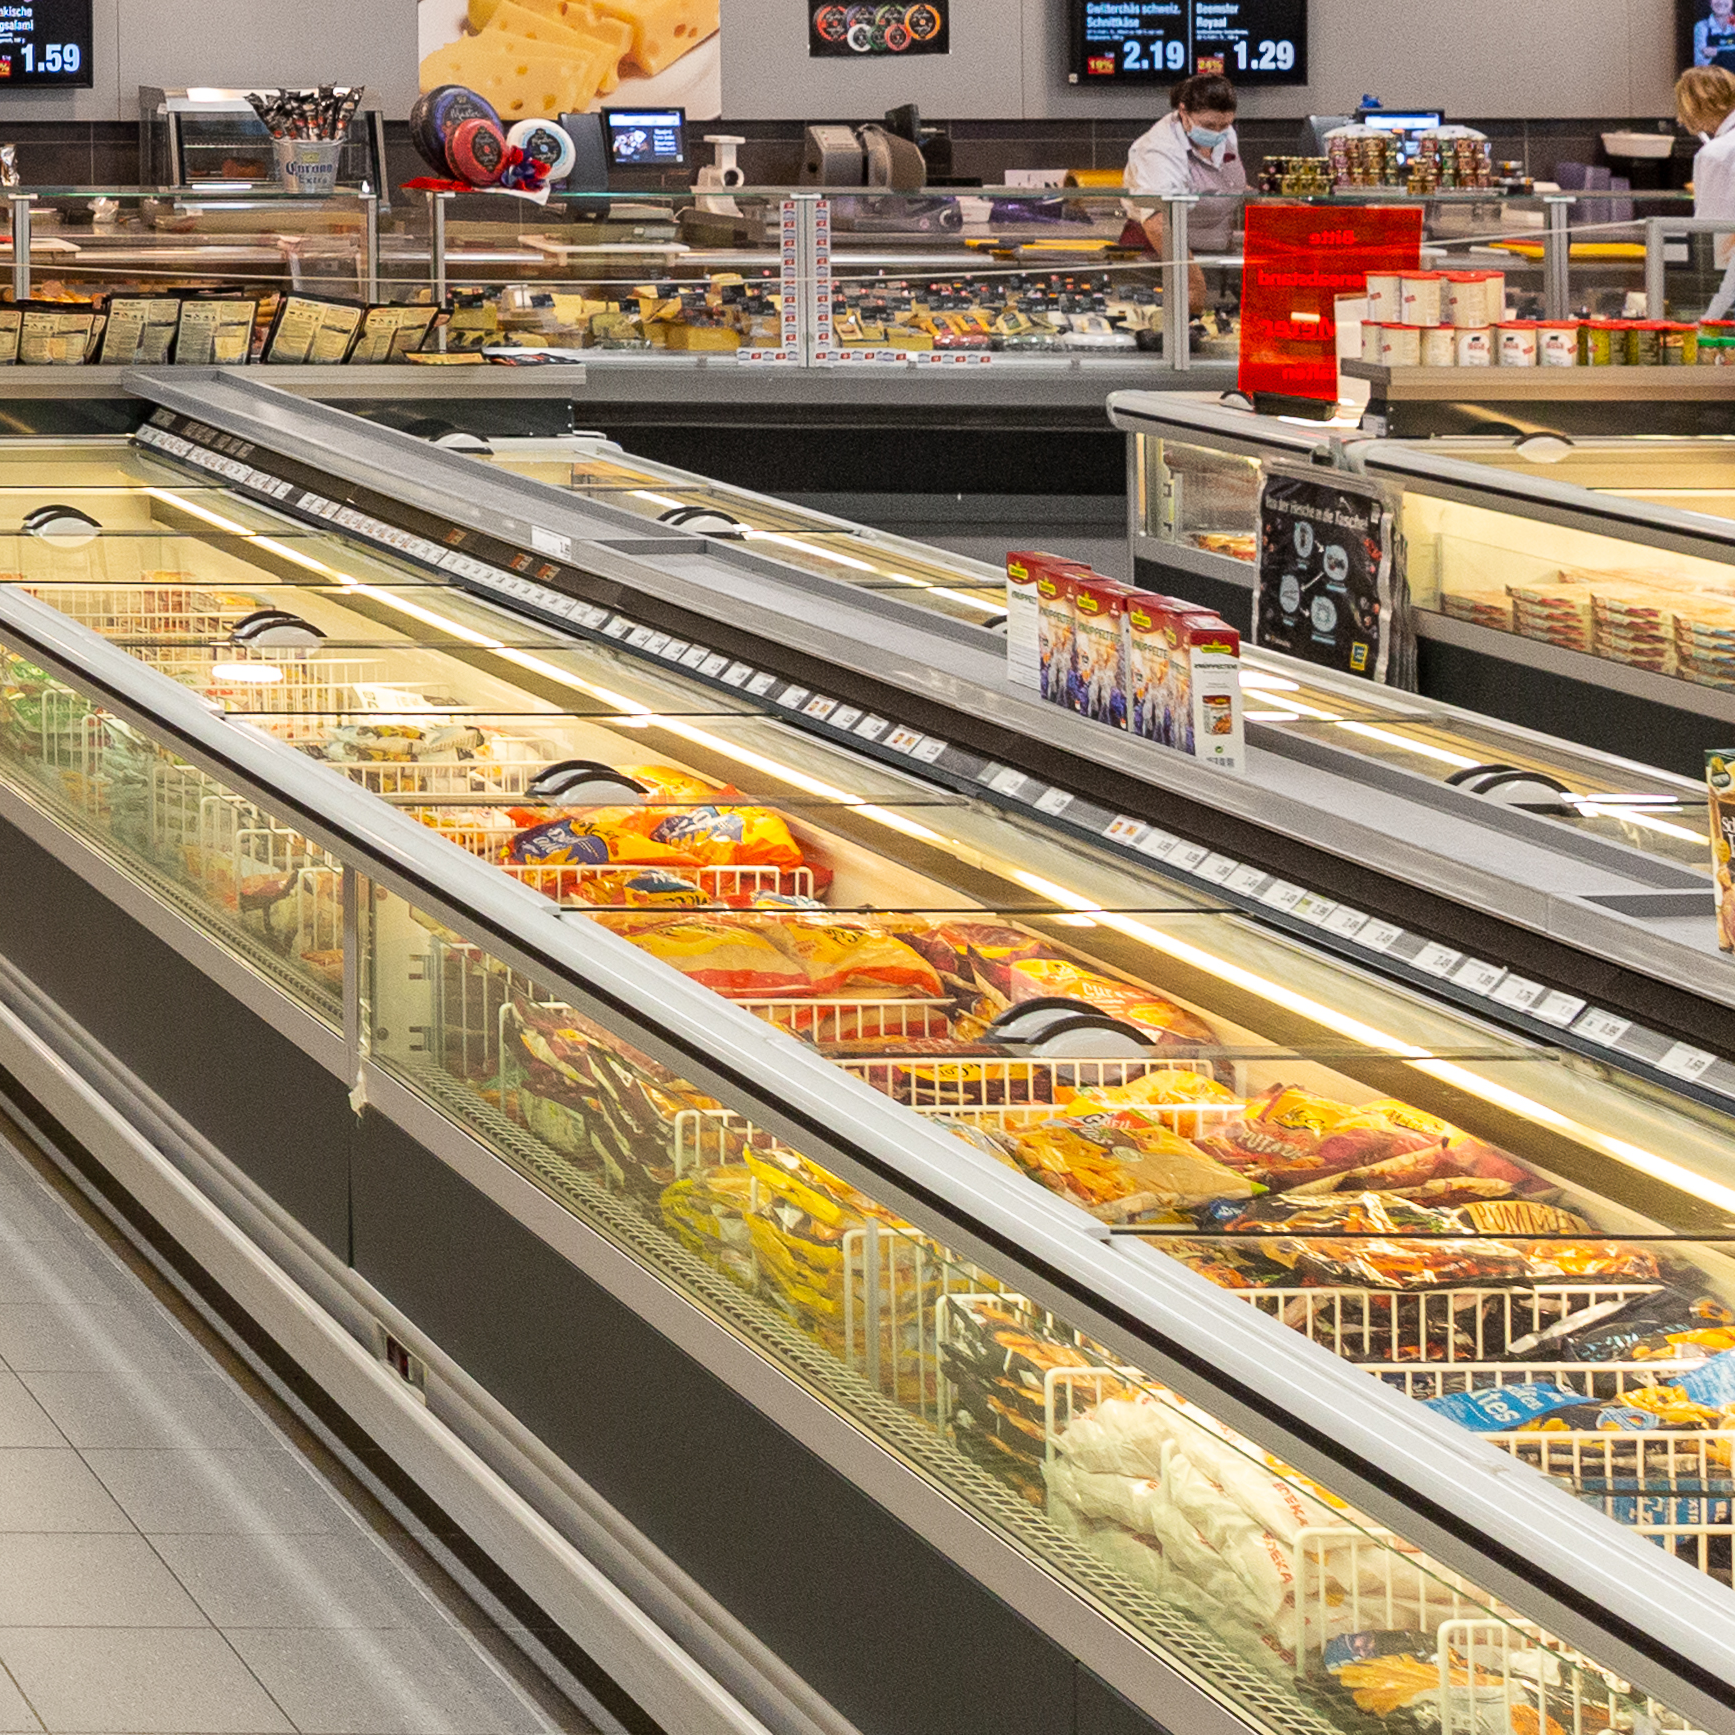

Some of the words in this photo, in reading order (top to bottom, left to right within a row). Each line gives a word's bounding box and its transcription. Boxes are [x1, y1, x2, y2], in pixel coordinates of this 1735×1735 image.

[20, 43, 81, 73] 1.59
[1123, 40, 1184, 70] 2.19
[1233, 40, 1295, 70] 1.29
[285, 161, 333, 176] Corona
[1272, 1481, 1309, 1527] EDEKA
